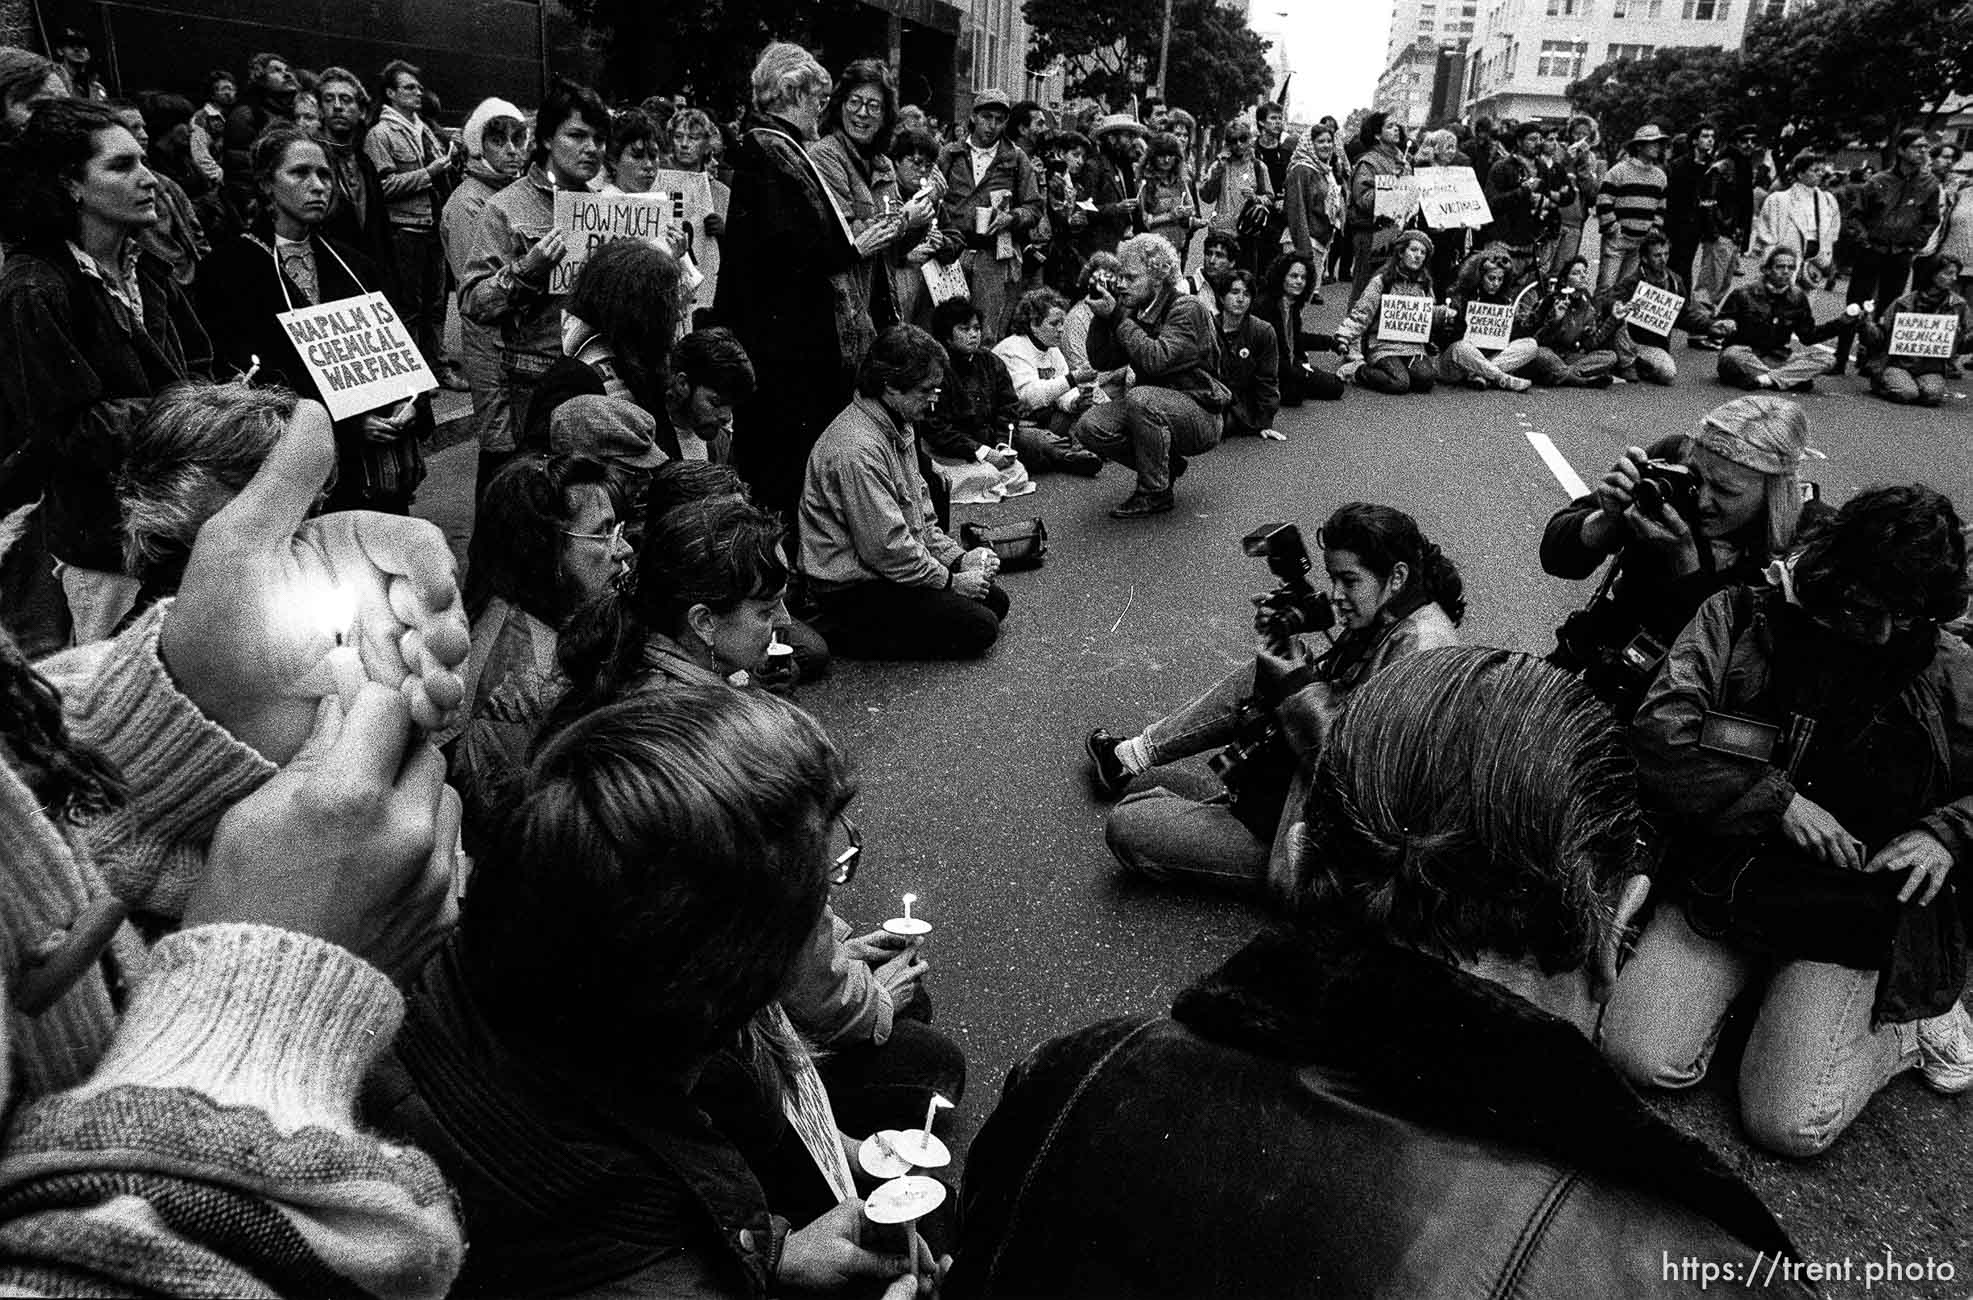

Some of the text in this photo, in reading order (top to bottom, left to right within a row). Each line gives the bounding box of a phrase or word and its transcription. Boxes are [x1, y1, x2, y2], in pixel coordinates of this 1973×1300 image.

[572, 202, 611, 231] HOW
[614, 204, 661, 237] MUCH
[1383, 300, 1432, 312] NAPALM IS
[1469, 304, 1514, 319] NAPALM IS
[286, 302, 394, 344] NAPALM IS
[1383, 310, 1429, 323] CHEMICAL
[1470, 316, 1509, 328] CHEMICAL
[1384, 320, 1428, 334] WARFARE
[1470, 325, 1508, 337] WARFARE
[1897, 317, 1956, 332] NAPALM IS
[1895, 329, 1950, 344] CHEMICAL
[308, 326, 405, 367] CHEMICAL
[1895, 342, 1950, 355] WARFARE
[321, 349, 422, 392] WARFARE
